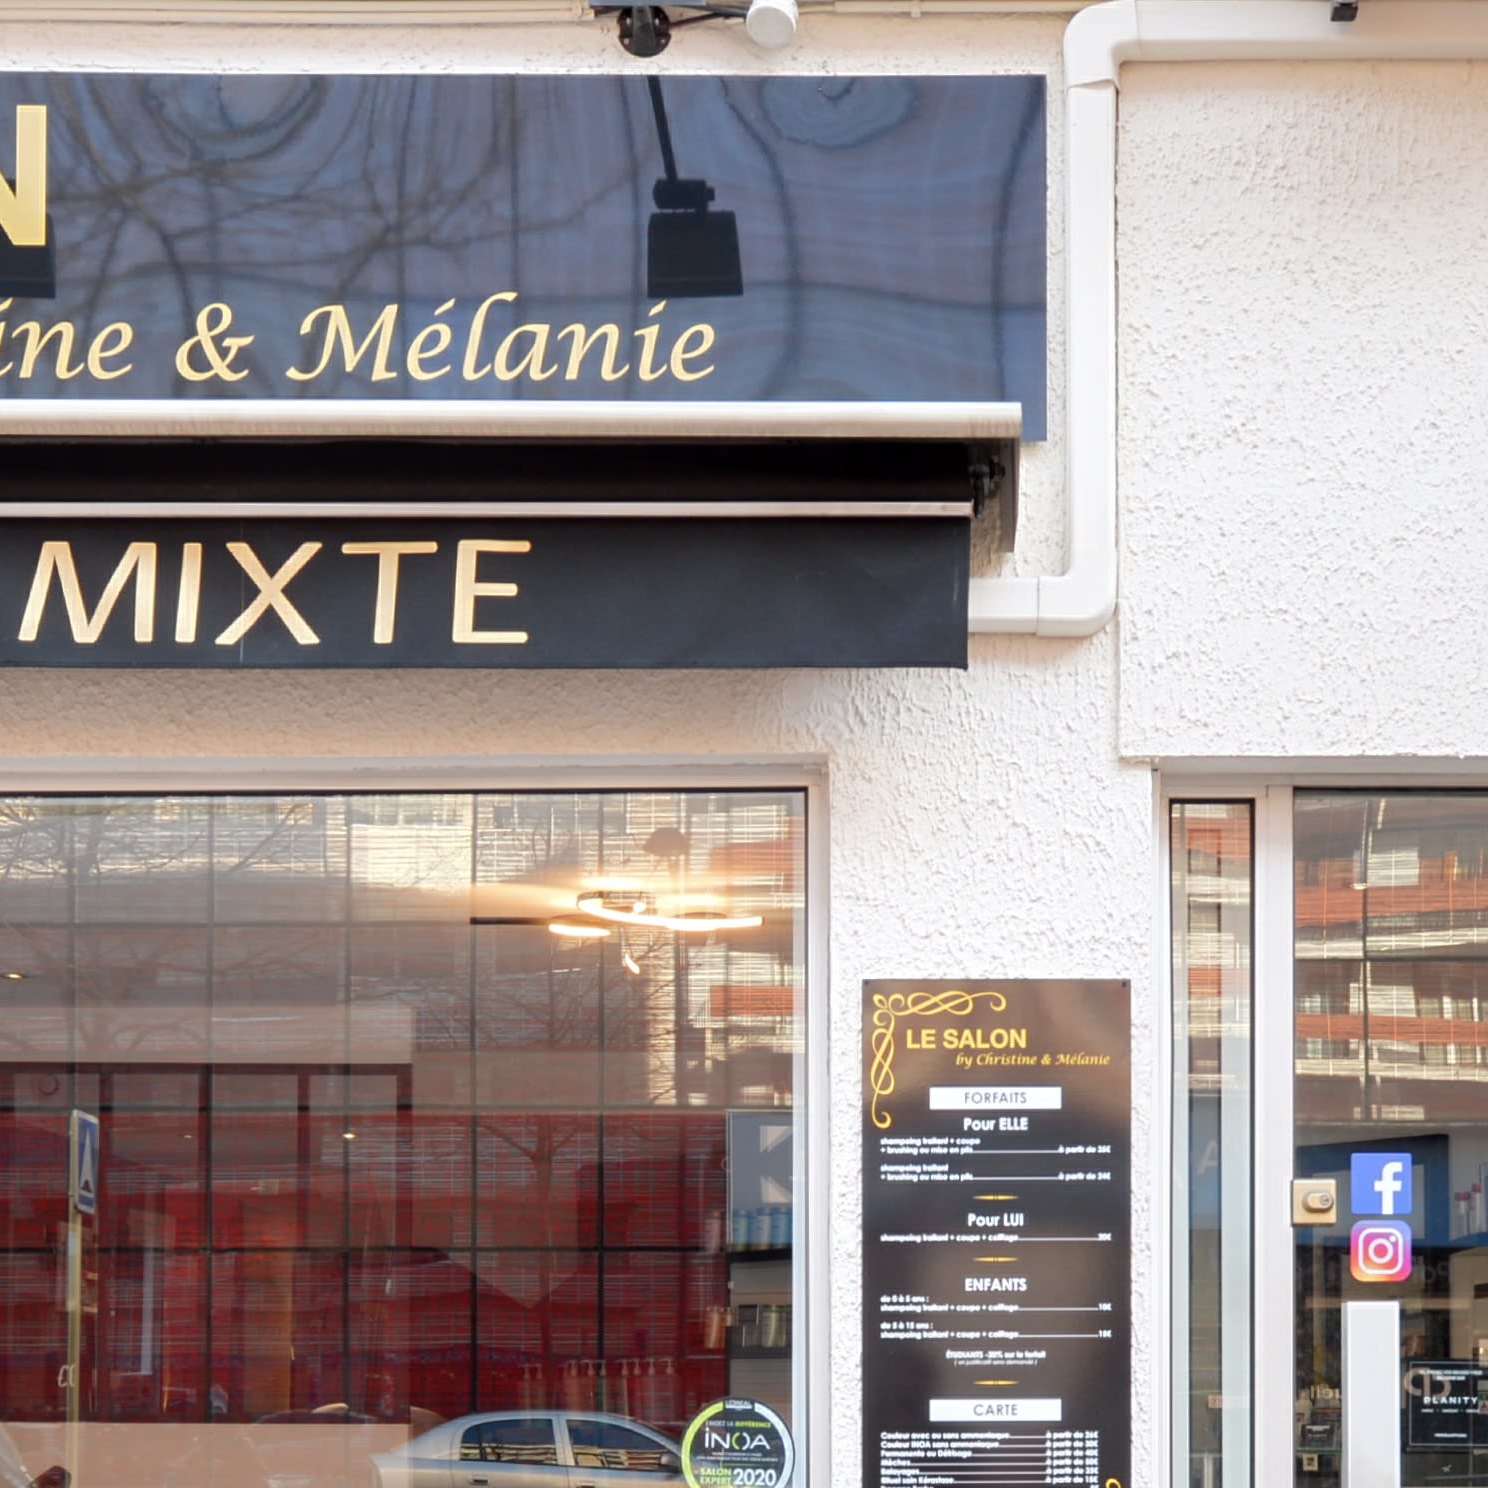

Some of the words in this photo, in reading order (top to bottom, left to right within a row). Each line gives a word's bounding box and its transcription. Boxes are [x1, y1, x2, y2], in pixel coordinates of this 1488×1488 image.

[174, 303, 254, 382] &
[284, 291, 715, 383] Mélanie
[18, 538, 532, 645] MIXTE
[906, 1028, 937, 1048] LE
[943, 1028, 1027, 1048] SALON
[956, 1052, 973, 1067] by
[975, 1052, 1037, 1066] Christine
[1041, 1053, 1052, 1066] &
[1055, 1052, 1110, 1066] Mélanie
[964, 1091, 1028, 1104] FORFAITS
[963, 1117, 996, 1131] Pour
[999, 1117, 1029, 1131] ELLE
[967, 1213, 1000, 1227] Pour
[1003, 1213, 1024, 1227] LUI
[965, 1278, 1027, 1291] ENFANTS
[973, 1404, 1018, 1416] CARTE
[700, 1468, 731, 1476] SALON
[733, 1468, 776, 1487] 2020
